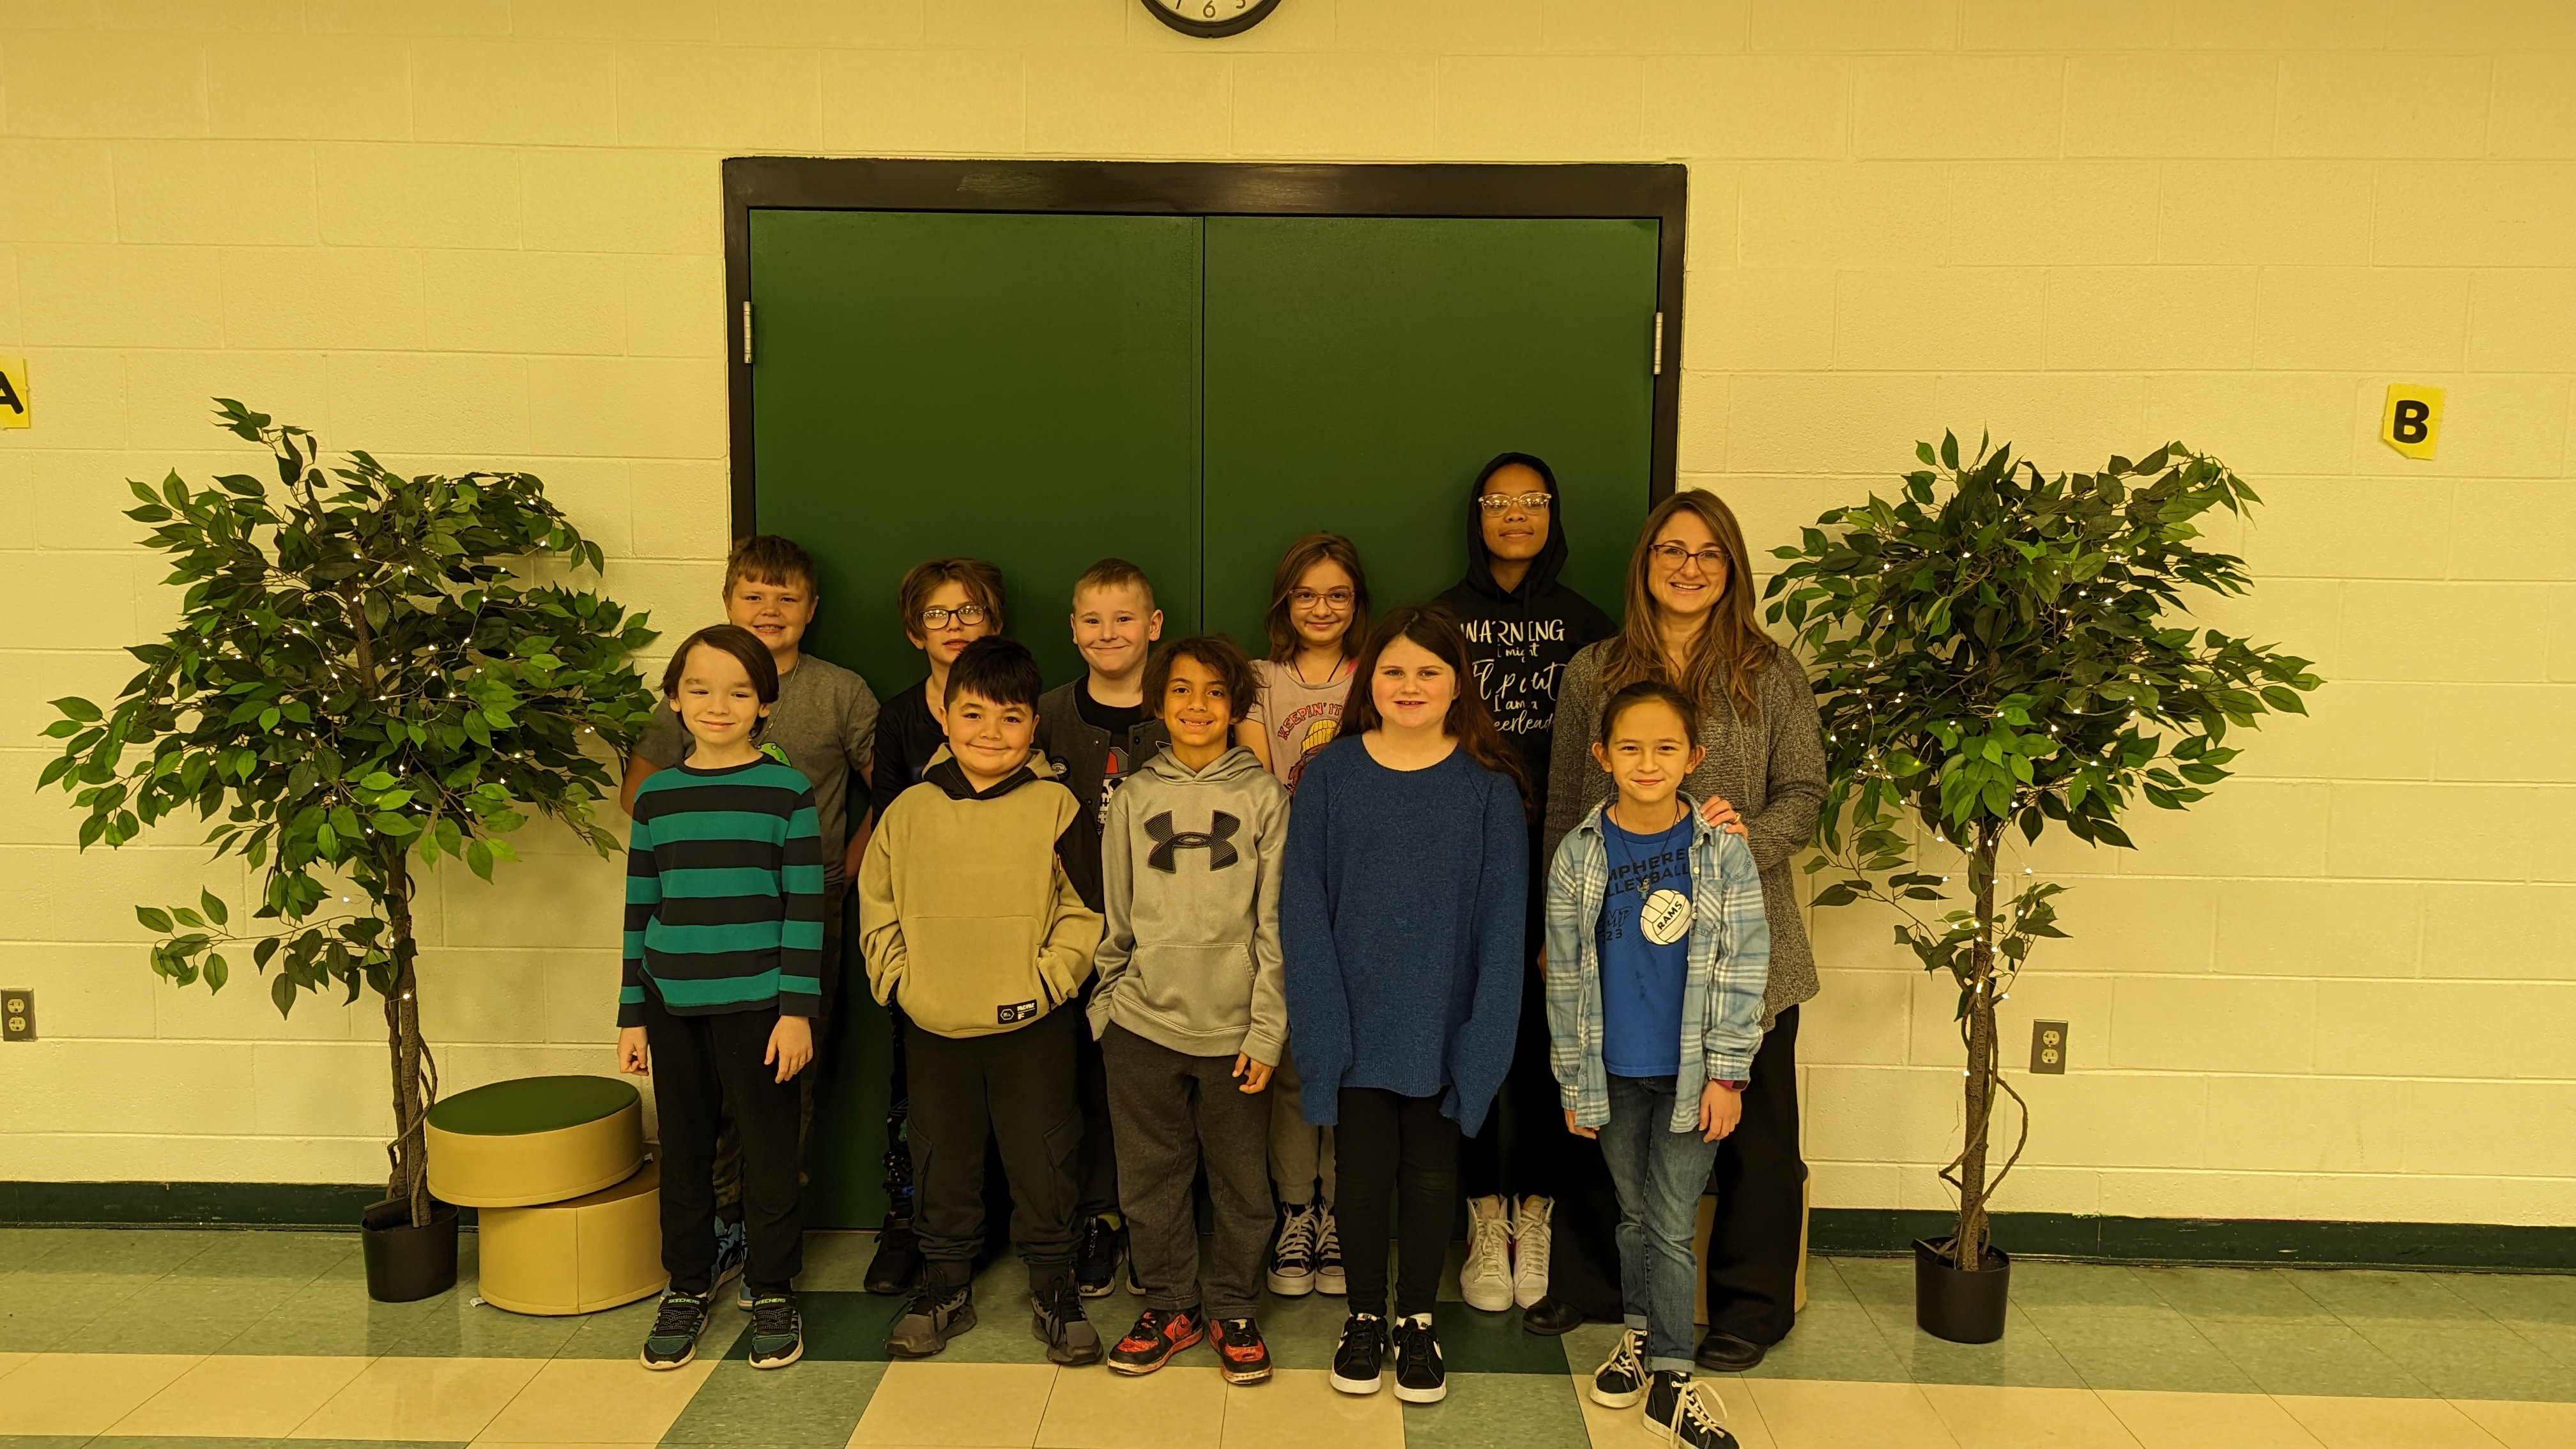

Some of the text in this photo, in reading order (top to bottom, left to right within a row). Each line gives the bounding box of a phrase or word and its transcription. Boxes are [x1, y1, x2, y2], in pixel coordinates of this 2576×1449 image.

[1202, 0, 1216, 19] 6
[2393, 400, 2429, 443] B
[1460, 619, 1565, 646] WARNING
[1471, 659, 1516, 699] Flp
[1494, 694, 1501, 712] I
[1505, 700, 1525, 710] am
[1278, 702, 1343, 740] KEEPIN' IT
[1494, 709, 1555, 735] eerlead
[1607, 862, 1690, 898] LLEYBALL
[1608, 848, 1685, 881] MPHERE
[1657, 900, 1683, 930] RAMS
